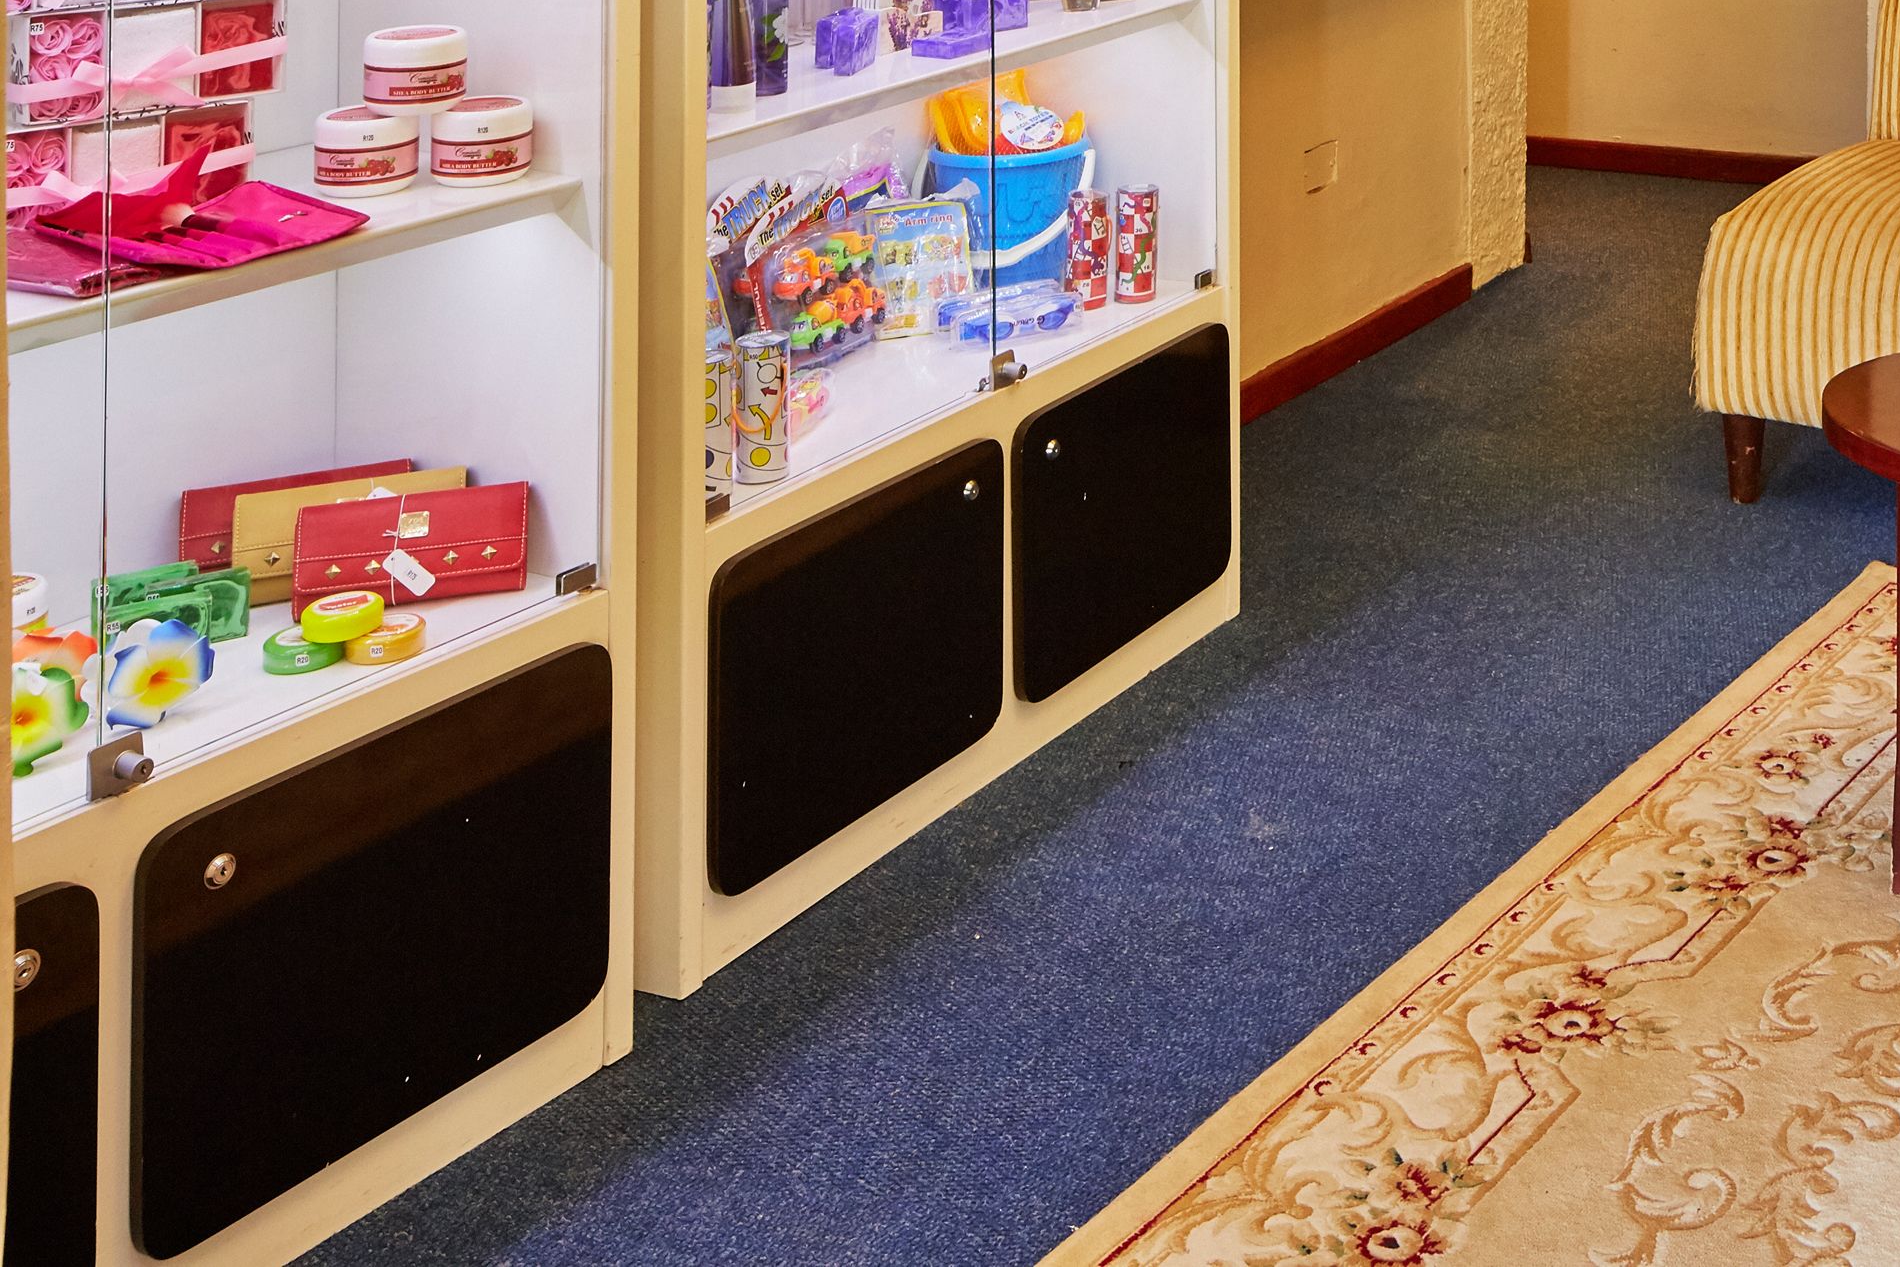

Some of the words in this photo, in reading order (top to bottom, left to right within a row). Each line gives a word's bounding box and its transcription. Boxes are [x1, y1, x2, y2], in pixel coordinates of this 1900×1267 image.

[30, 24, 43, 32] R75
[722, 178, 770, 240] TRUCK
[771, 182, 784, 202] set
[759, 228, 774, 246] The
[821, 185, 834, 204] set
[905, 217, 927, 226] Arm
[930, 214, 953, 223] ring
[106, 623, 120, 632] R55
[296, 656, 309, 665] R20
